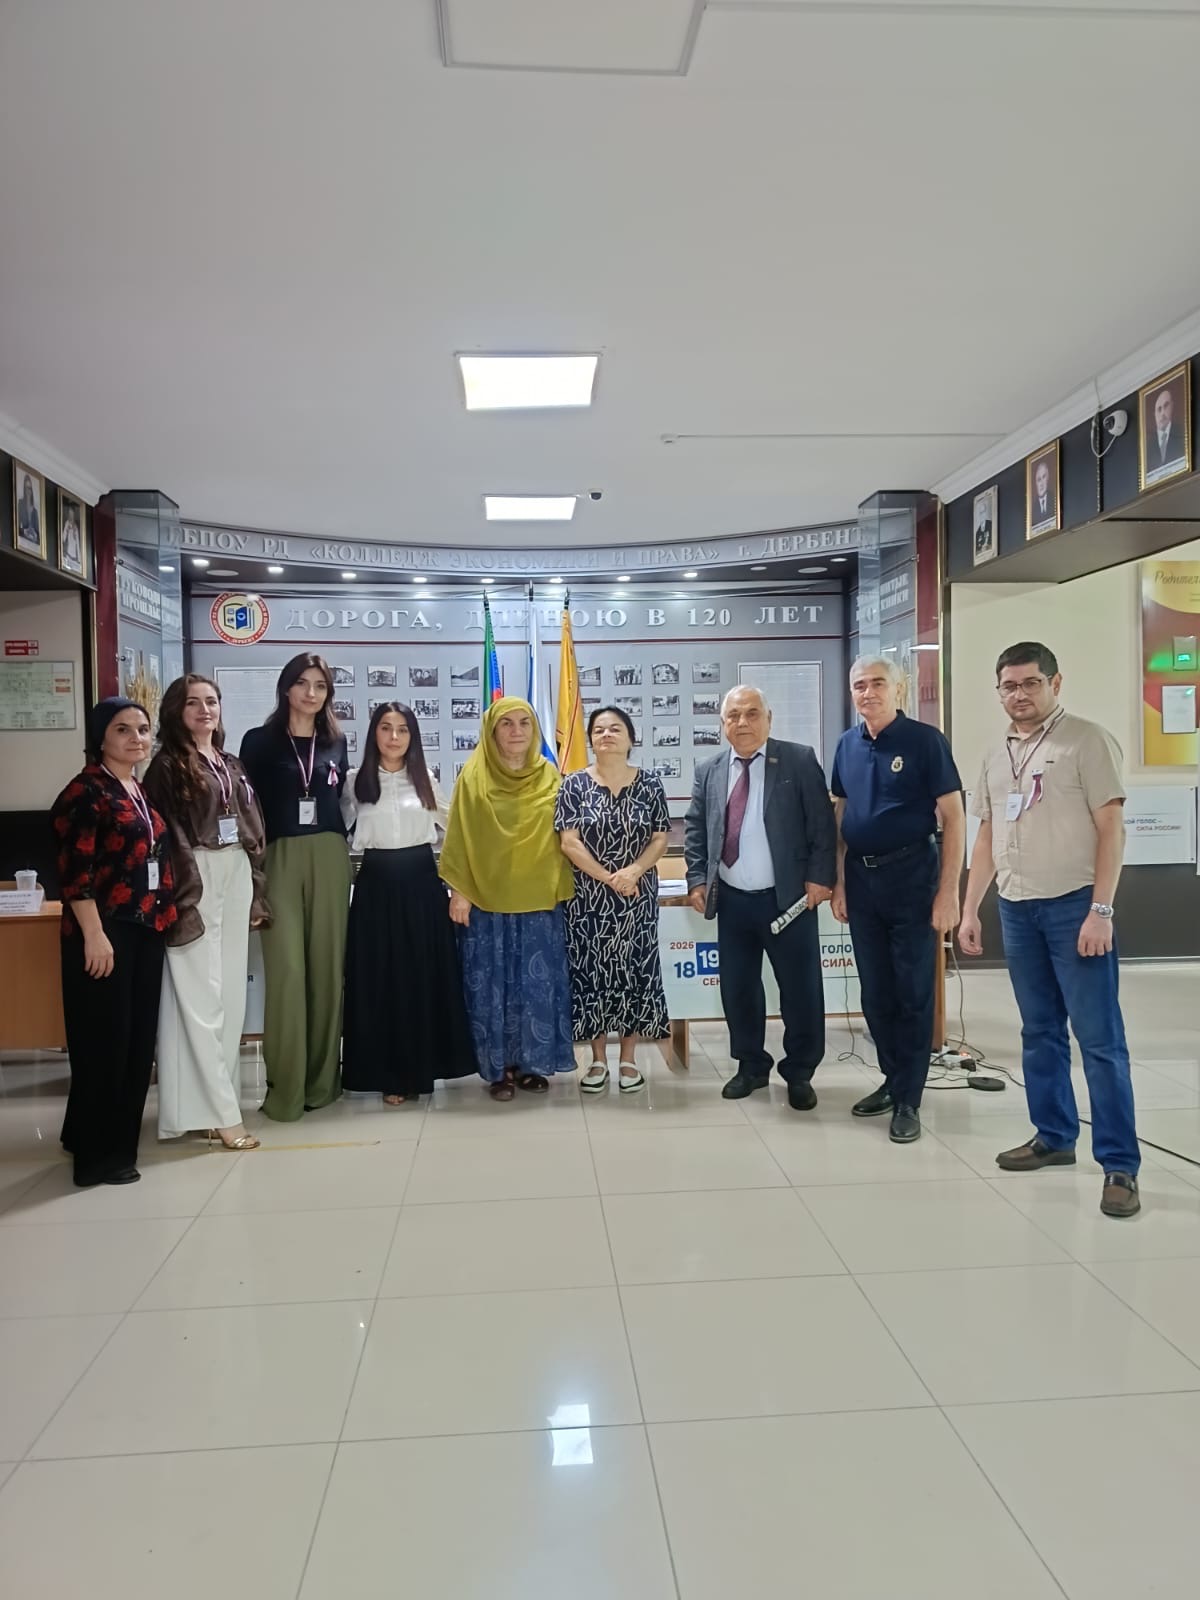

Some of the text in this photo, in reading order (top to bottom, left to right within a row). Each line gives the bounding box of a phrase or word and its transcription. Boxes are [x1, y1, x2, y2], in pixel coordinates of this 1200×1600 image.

[262, 537, 288, 558] РД
[612, 551, 626, 566] И
[285, 608, 443, 631] ДОРОГА,
[647, 608, 666, 626] В
[688, 608, 731, 626] 120
[754, 605, 823, 625] ЛЕТ
[674, 950, 719, 978] 18 19
[822, 959, 853, 968] СИЛА
